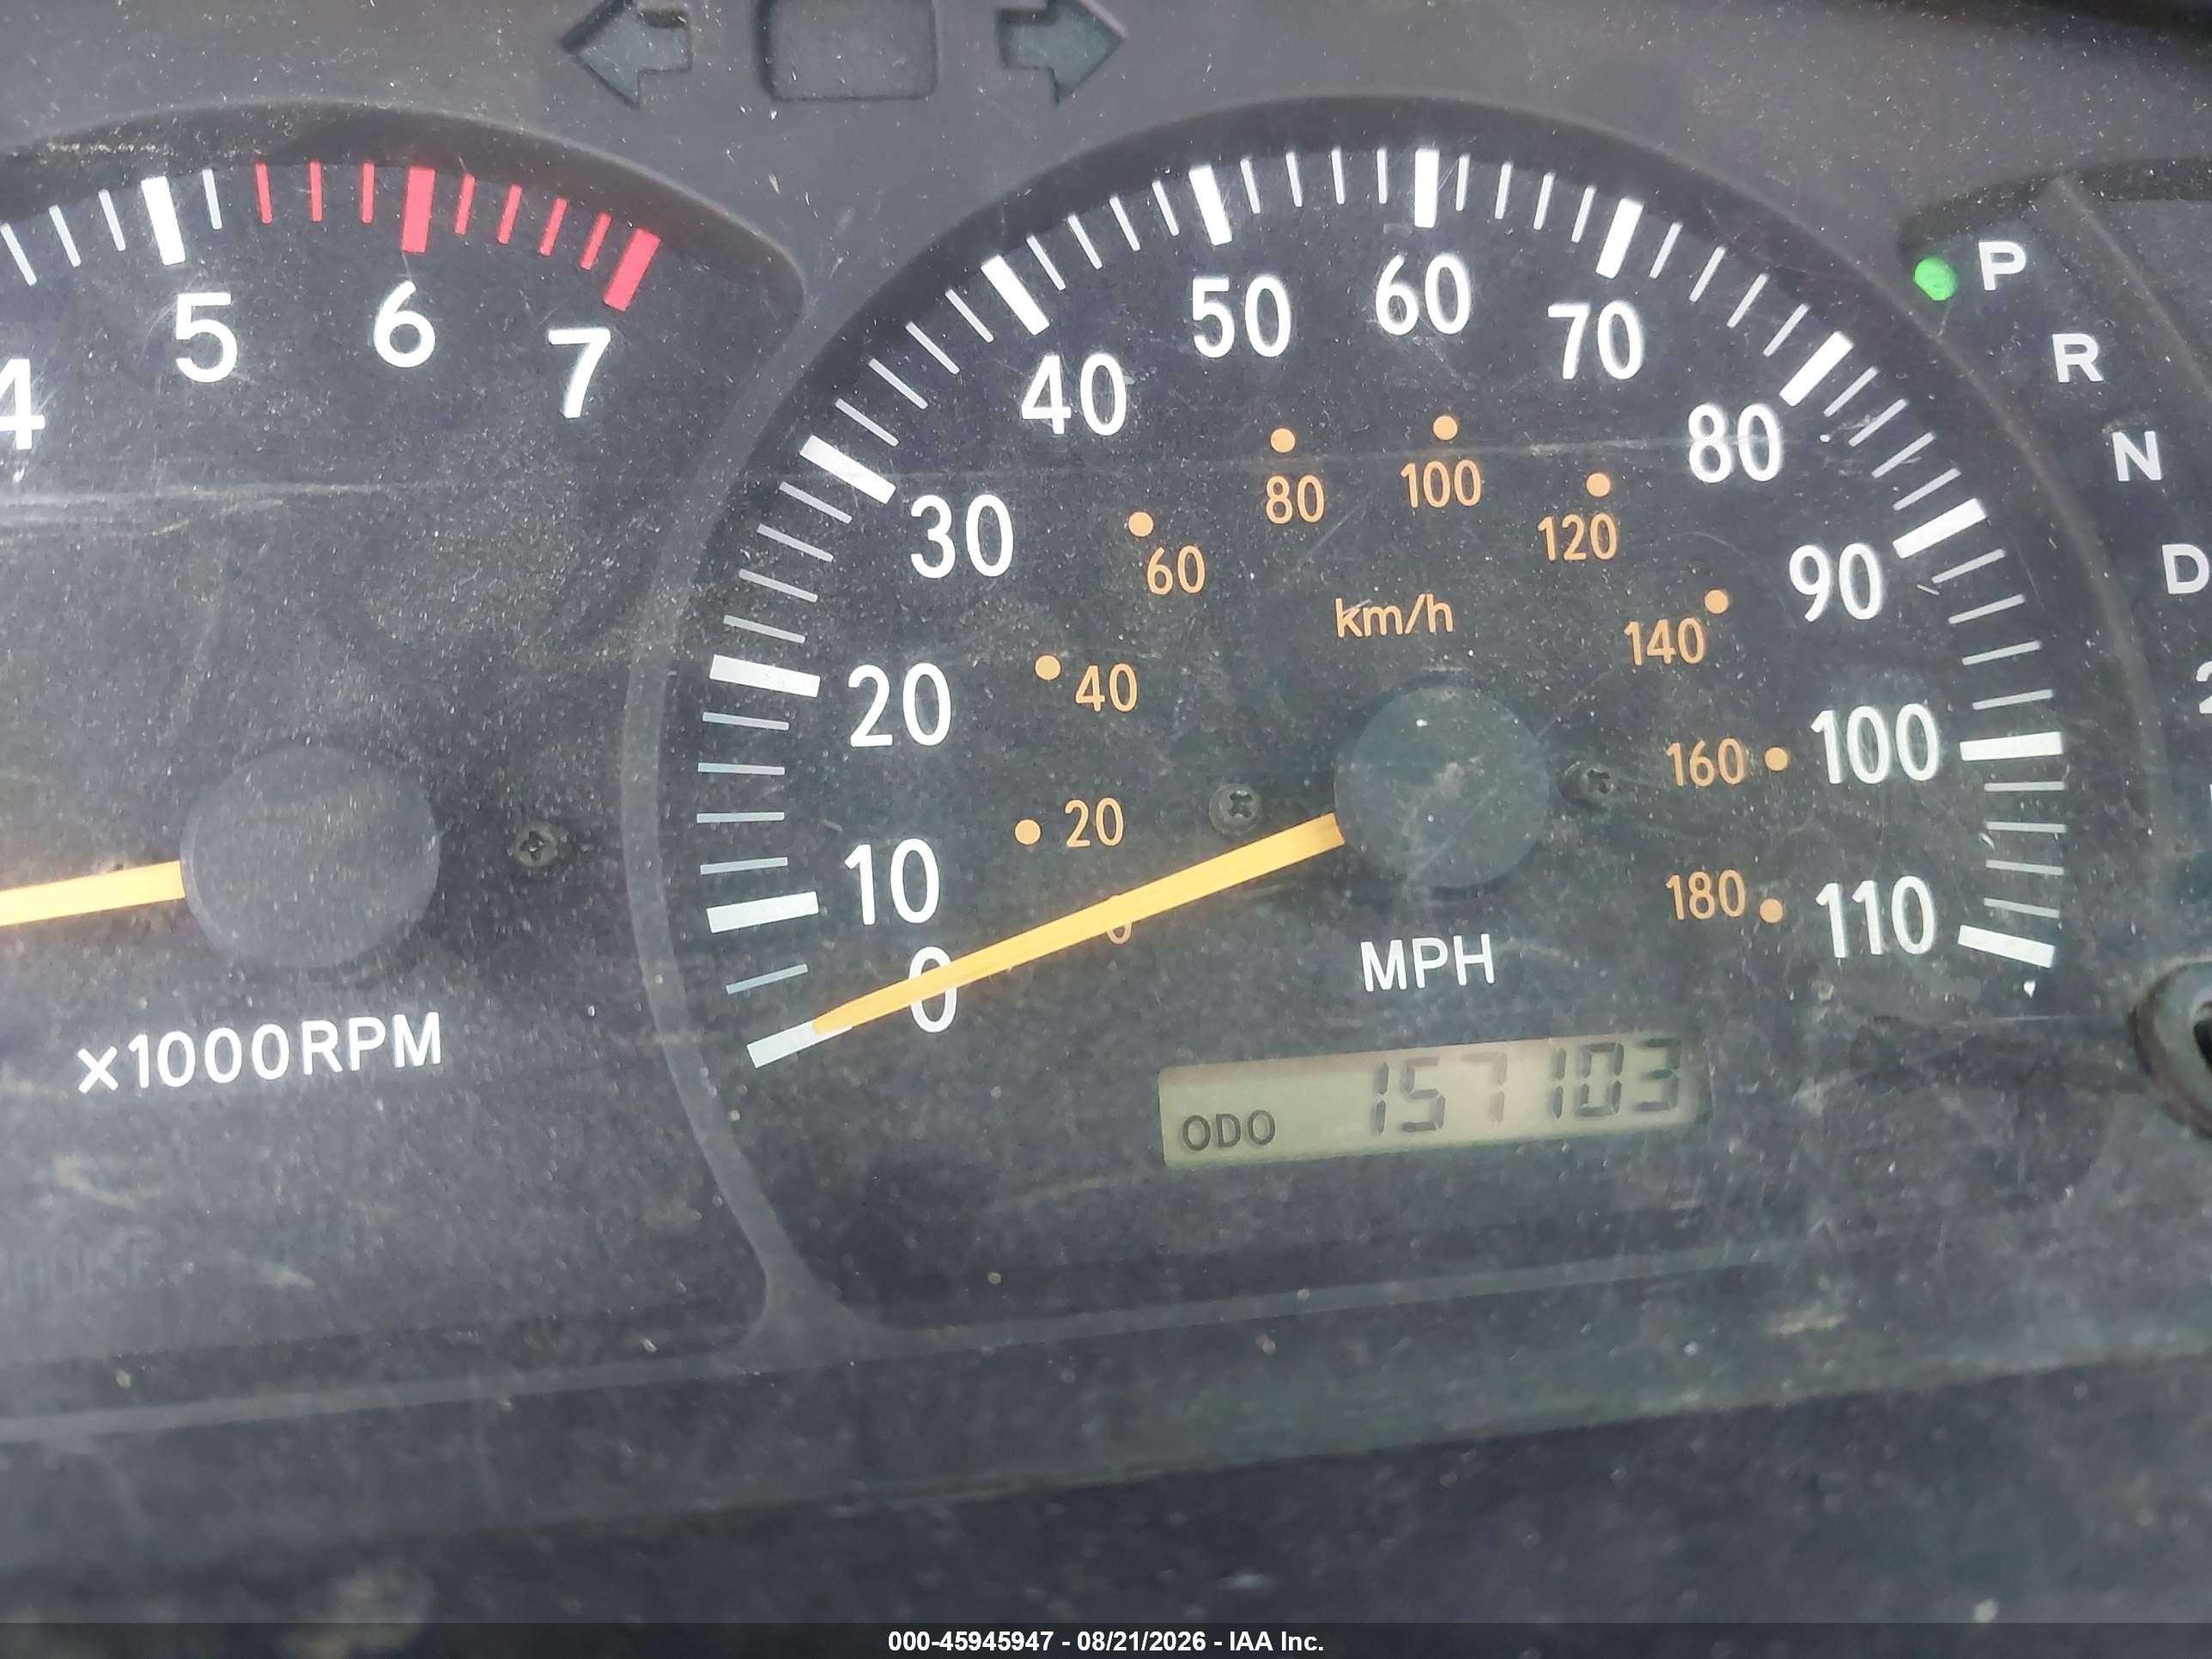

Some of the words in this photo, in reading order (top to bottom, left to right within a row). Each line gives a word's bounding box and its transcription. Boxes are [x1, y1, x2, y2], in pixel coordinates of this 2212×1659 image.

[1375, 251, 1474, 336] 60
[1978, 240, 2027, 291] P
[175, 291, 239, 384] 5
[372, 278, 436, 368] 6
[1192, 273, 1292, 358] 50
[1547, 299, 1645, 380] 70
[547, 325, 611, 419] 7
[1020, 353, 1129, 436] 40
[2051, 332, 2105, 383] R
[0, 358, 46, 451] 4
[1686, 402, 1784, 483] 80
[1402, 459, 1481, 508] 100
[2112, 430, 2162, 482] N
[910, 493, 1014, 579] 30
[1266, 474, 1325, 523] 80
[1539, 513, 1618, 561] 120
[1146, 545, 1206, 596] 60
[1789, 542, 1885, 623] 90
[2161, 543, 2210, 594] D
[1335, 593, 1453, 636] km/h
[1625, 617, 1705, 665] 140
[848, 662, 951, 748] 20
[1075, 663, 1138, 712] 40
[1668, 738, 1746, 786] 160
[1810, 702, 1942, 785] 100
[1065, 797, 1123, 848] 20
[844, 838, 940, 926] 10
[1668, 870, 1746, 918] 180
[1815, 875, 1937, 959] 110
[1360, 933, 1495, 993] MPH
[1182, 1109, 1277, 1152] ODO
[1371, 1036, 1681, 1134] 157103
